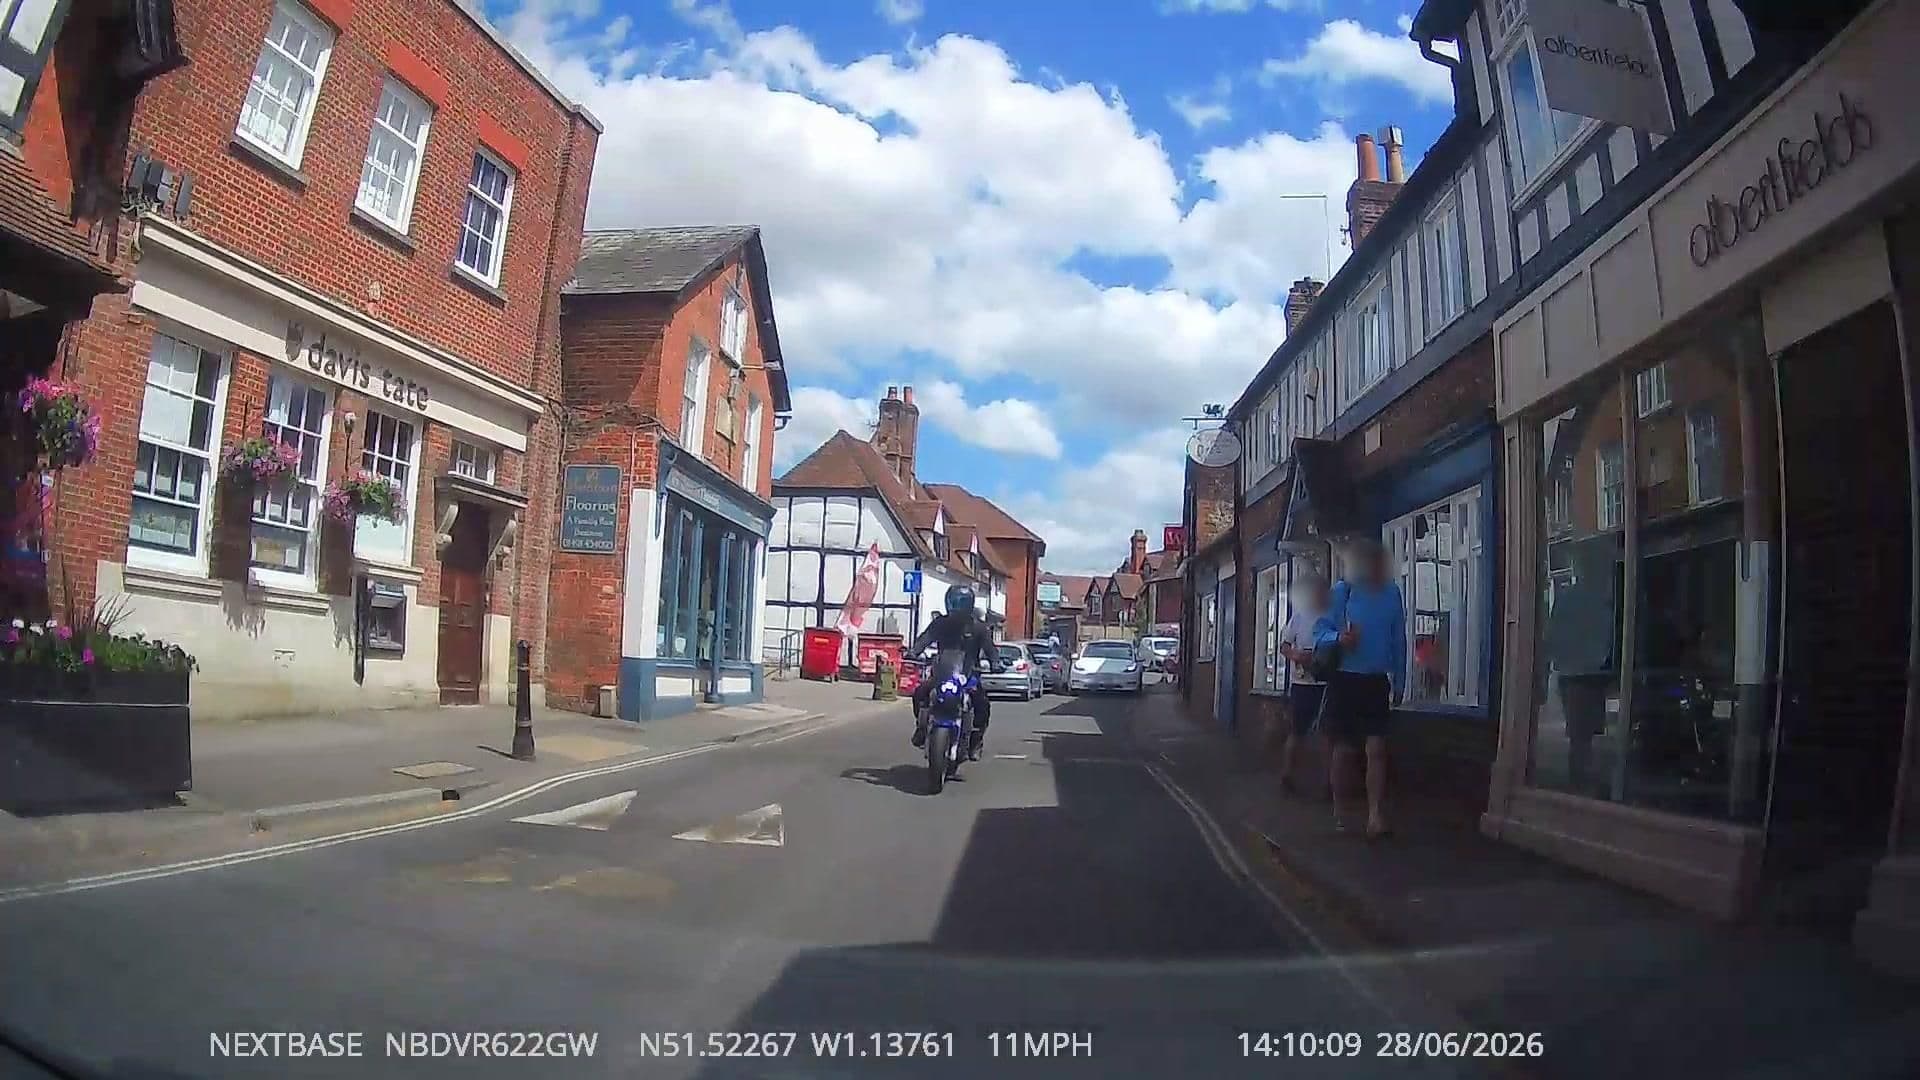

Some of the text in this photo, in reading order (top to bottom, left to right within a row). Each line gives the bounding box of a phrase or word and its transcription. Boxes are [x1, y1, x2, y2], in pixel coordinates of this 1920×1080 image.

[1689, 91, 1872, 268] albertfields
[307, 332, 429, 411] davis tate
[565, 495, 617, 515] Flooring
